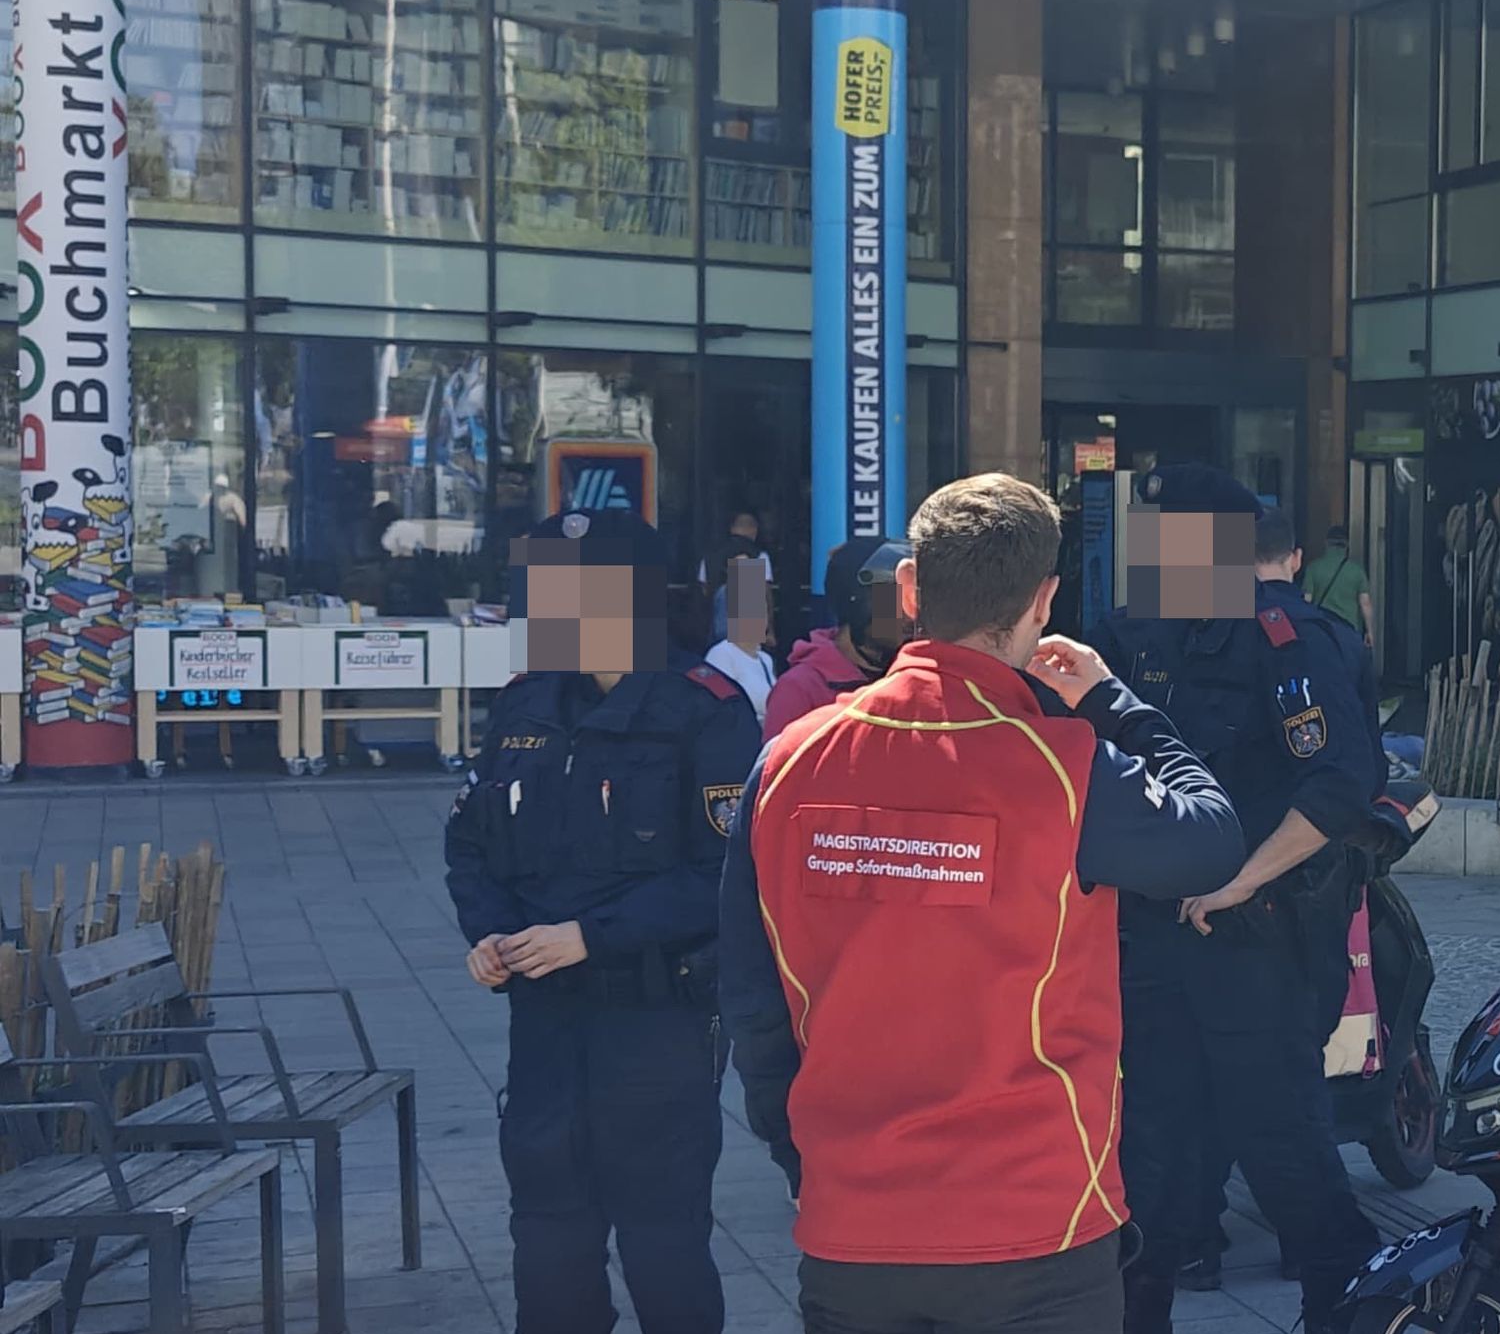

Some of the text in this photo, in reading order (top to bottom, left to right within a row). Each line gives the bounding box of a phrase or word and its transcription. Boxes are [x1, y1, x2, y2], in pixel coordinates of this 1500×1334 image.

[844, 50, 864, 121] HOFER
[46, 12, 110, 423] Buchmarkt
[854, 145, 880, 538] LLE KAUFEN ALLES EIN ZUM
[807, 854, 985, 884] Gruppe Sofortmaßnahmen
[813, 832, 982, 860] MAGISTRATSDIREKTION
